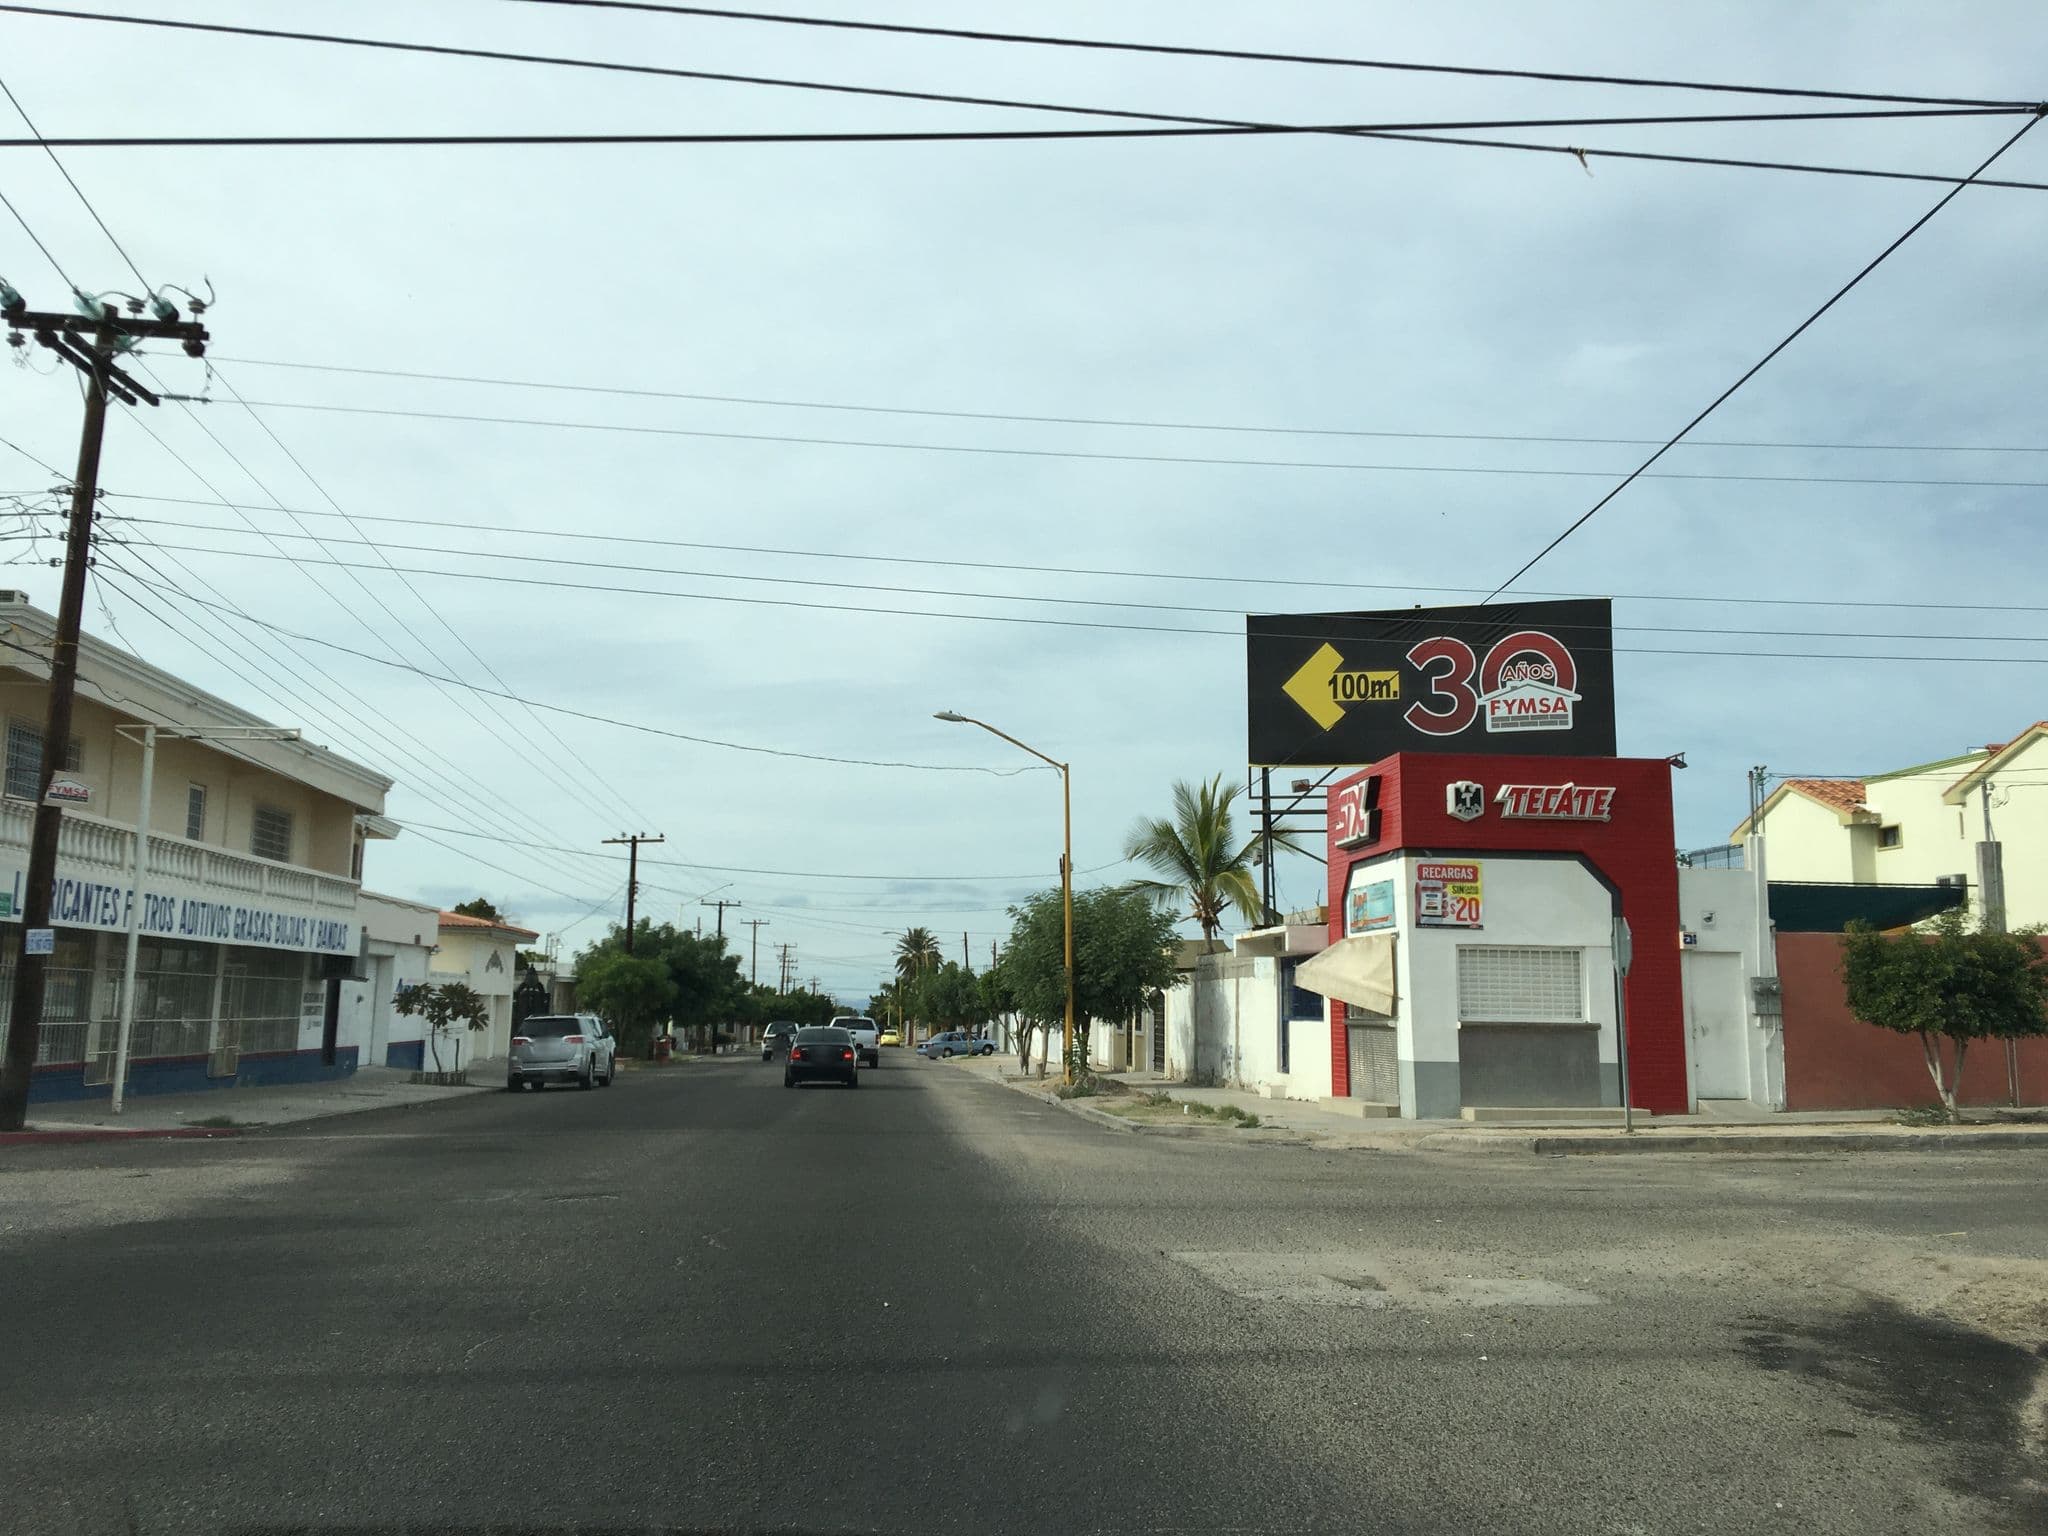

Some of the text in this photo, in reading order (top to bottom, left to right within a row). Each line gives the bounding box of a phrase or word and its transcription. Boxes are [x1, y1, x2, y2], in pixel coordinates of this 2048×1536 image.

[1403, 630, 1577, 736] 30
[1502, 660, 1555, 682] AÑOS
[1328, 673, 1398, 700] 100m.
[1490, 697, 1568, 715] FYMSA
[48, 785, 89, 798] FYMSA
[1500, 783, 1614, 818] TECATE
[1422, 867, 1473, 880] RECARGAS
[12, 870, 120, 926] LRICANTES
[123, 890, 175, 932] FTROS
[179, 899, 231, 939] ADITIVOS
[233, 906, 273, 943] GRASAS
[274, 914, 307, 948] BUJIAS
[308, 918, 316, 948] Y
[316, 919, 348, 951] BANDAS
